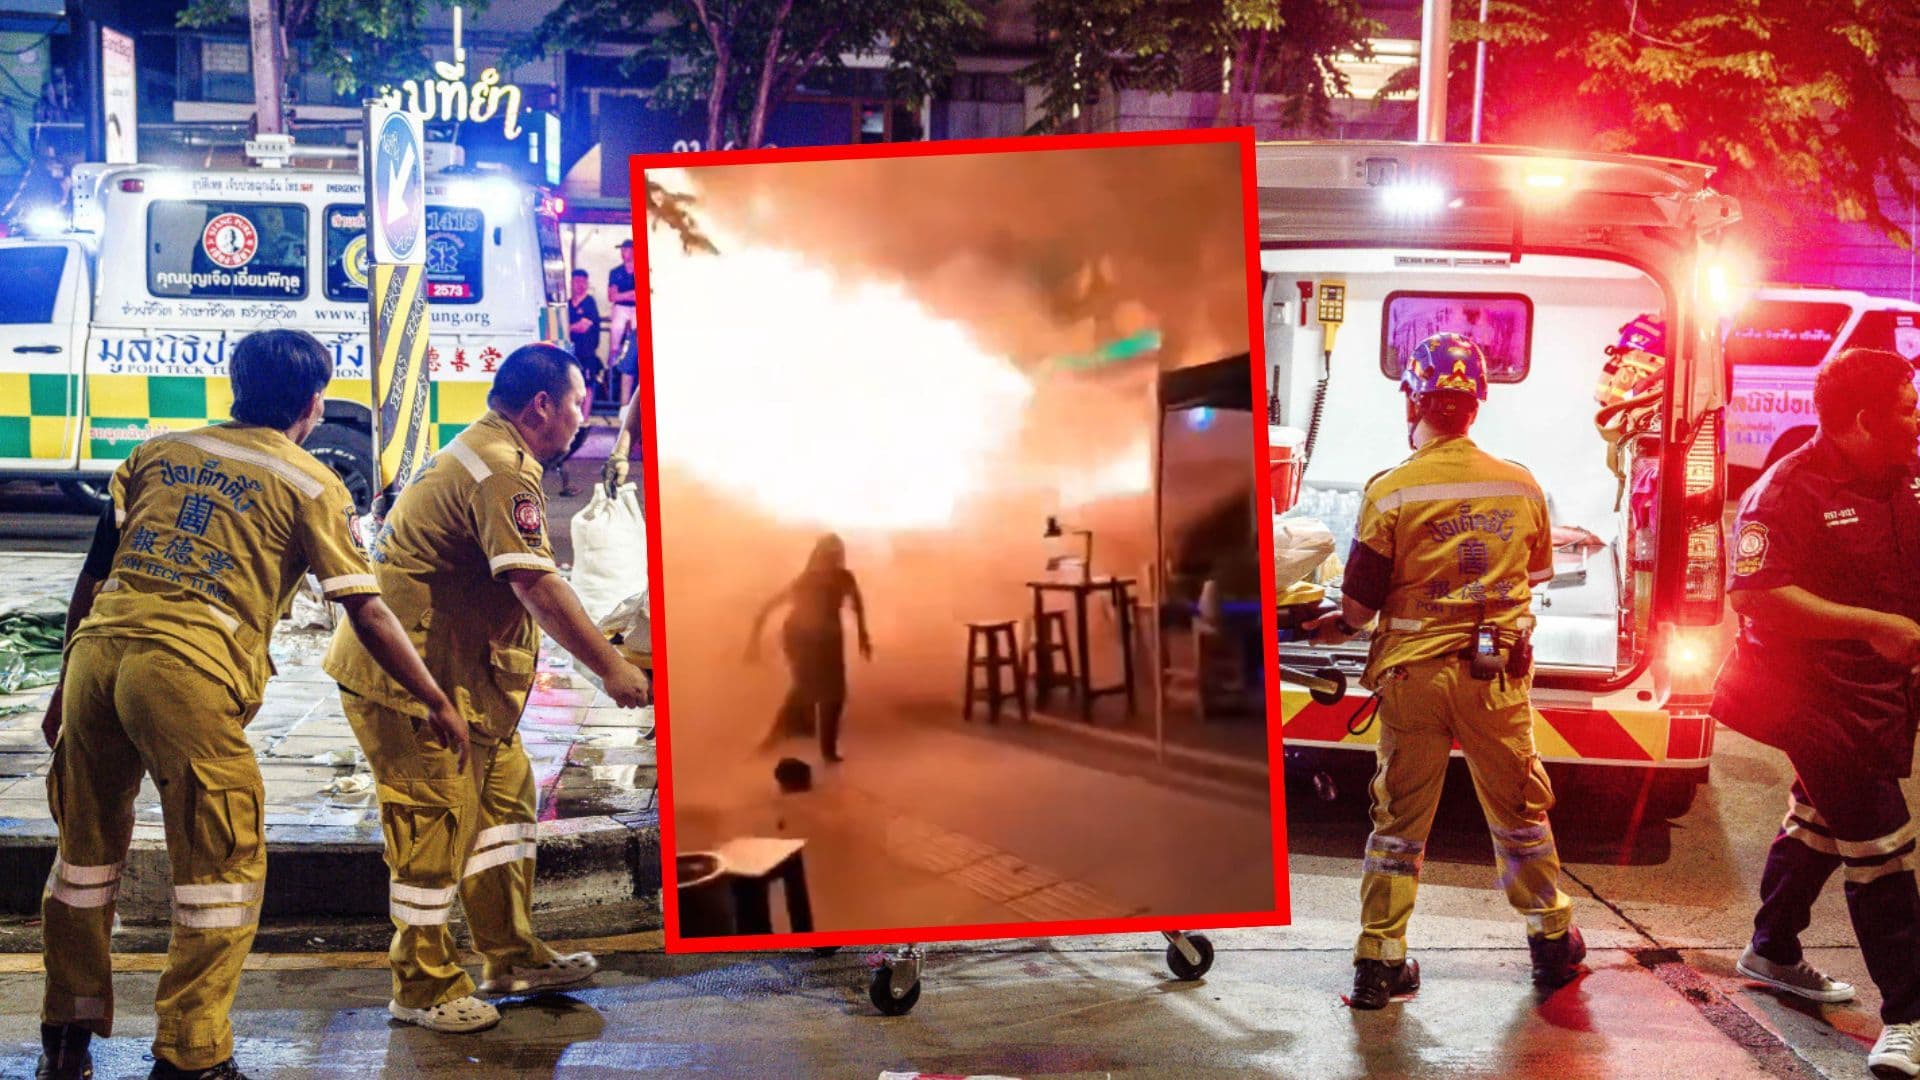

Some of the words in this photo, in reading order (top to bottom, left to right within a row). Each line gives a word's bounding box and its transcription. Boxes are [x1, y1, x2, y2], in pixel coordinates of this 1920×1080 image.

[326, 183, 361, 193] EMERGENCY
[157, 270, 231, 289] คุณบุญเจือ
[234, 266, 300, 292] เอี่ยมพิกุล
[433, 284, 464, 297] 2573
[128, 364, 159, 374] POH
[166, 364, 206, 376] TECK
[145, 561, 185, 584] TECK
